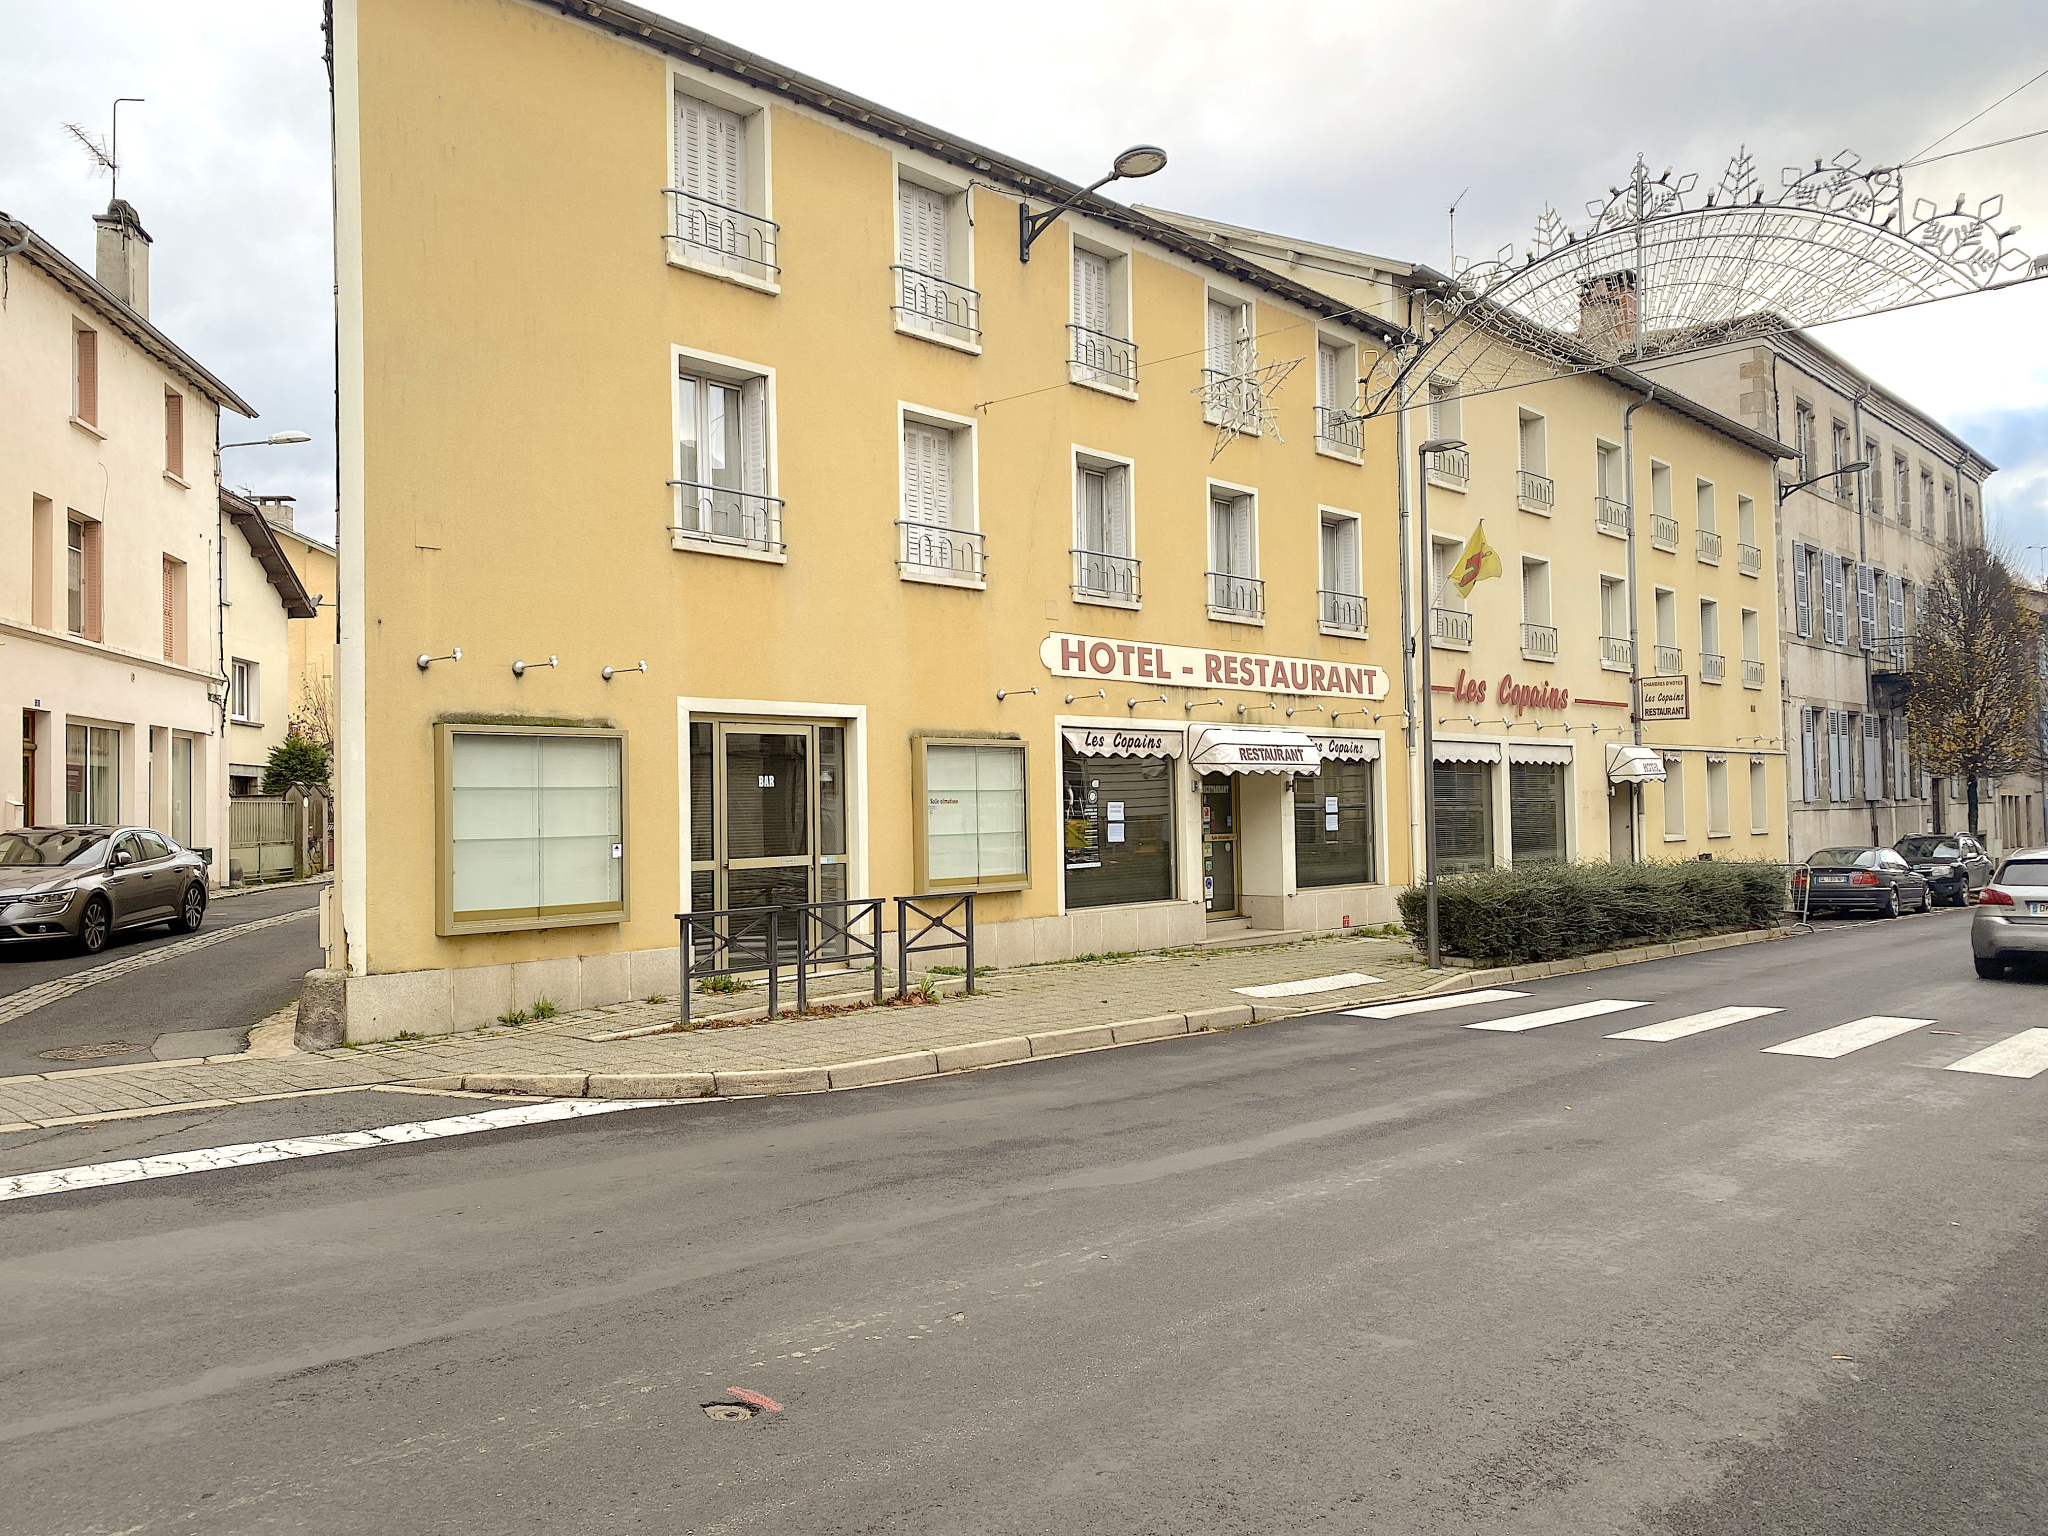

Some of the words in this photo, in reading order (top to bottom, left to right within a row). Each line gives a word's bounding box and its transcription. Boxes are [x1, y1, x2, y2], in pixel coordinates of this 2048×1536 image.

[1061, 638, 1171, 679] HOTEL
[1182, 666, 1193, 674] -
[1205, 653, 1376, 695] RESTAURANT
[1456, 669, 1486, 702] Les
[1499, 674, 1568, 716] Copains
[1645, 693, 1655, 702] Les
[1657, 692, 1684, 704] Copains
[1645, 707, 1684, 716] RESTAURANT
[1085, 731, 1105, 747] Les
[1113, 732, 1162, 753] Copains
[1328, 739, 1364, 757] Copains
[1239, 747, 1304, 762] RESTAURANT
[758, 775, 775, 788] BAR
